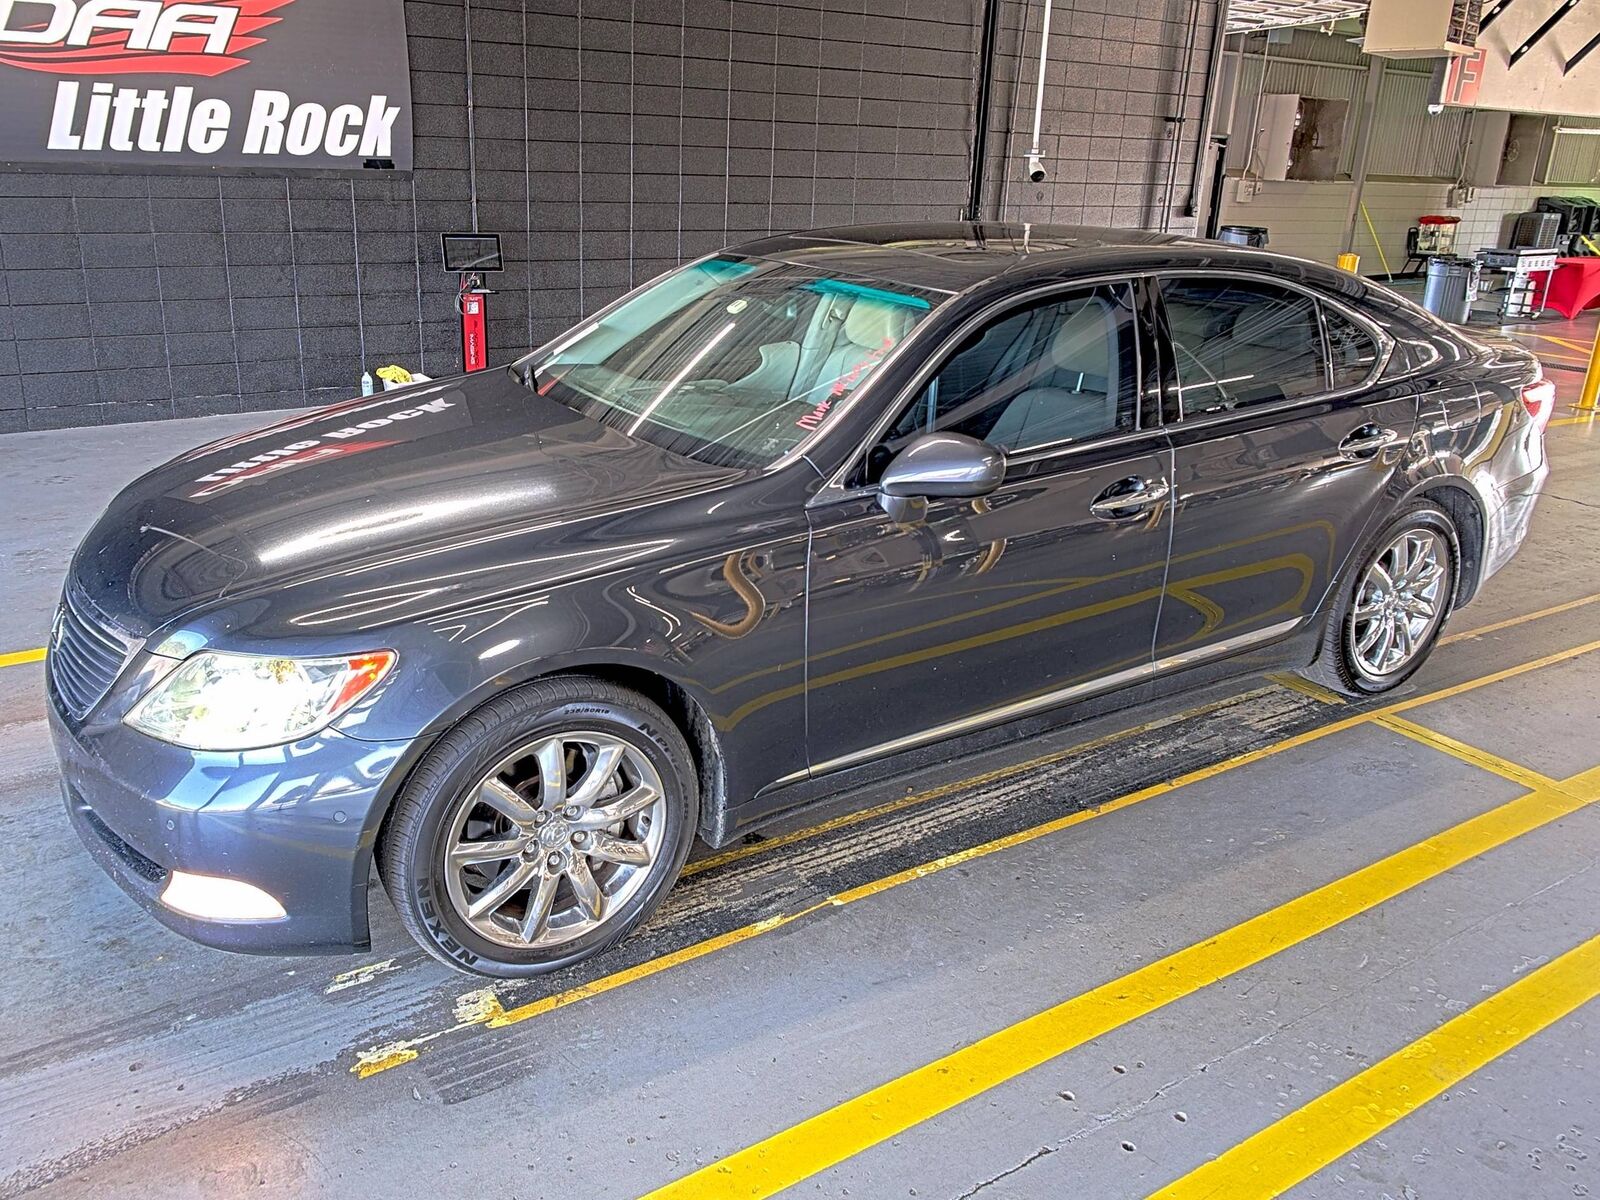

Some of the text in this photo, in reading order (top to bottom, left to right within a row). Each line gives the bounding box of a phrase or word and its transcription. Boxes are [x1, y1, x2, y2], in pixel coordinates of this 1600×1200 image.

[0, 0, 241, 54] DAA
[46, 81, 401, 157] Little Rock
[416, 878, 480, 966] NEXEN
